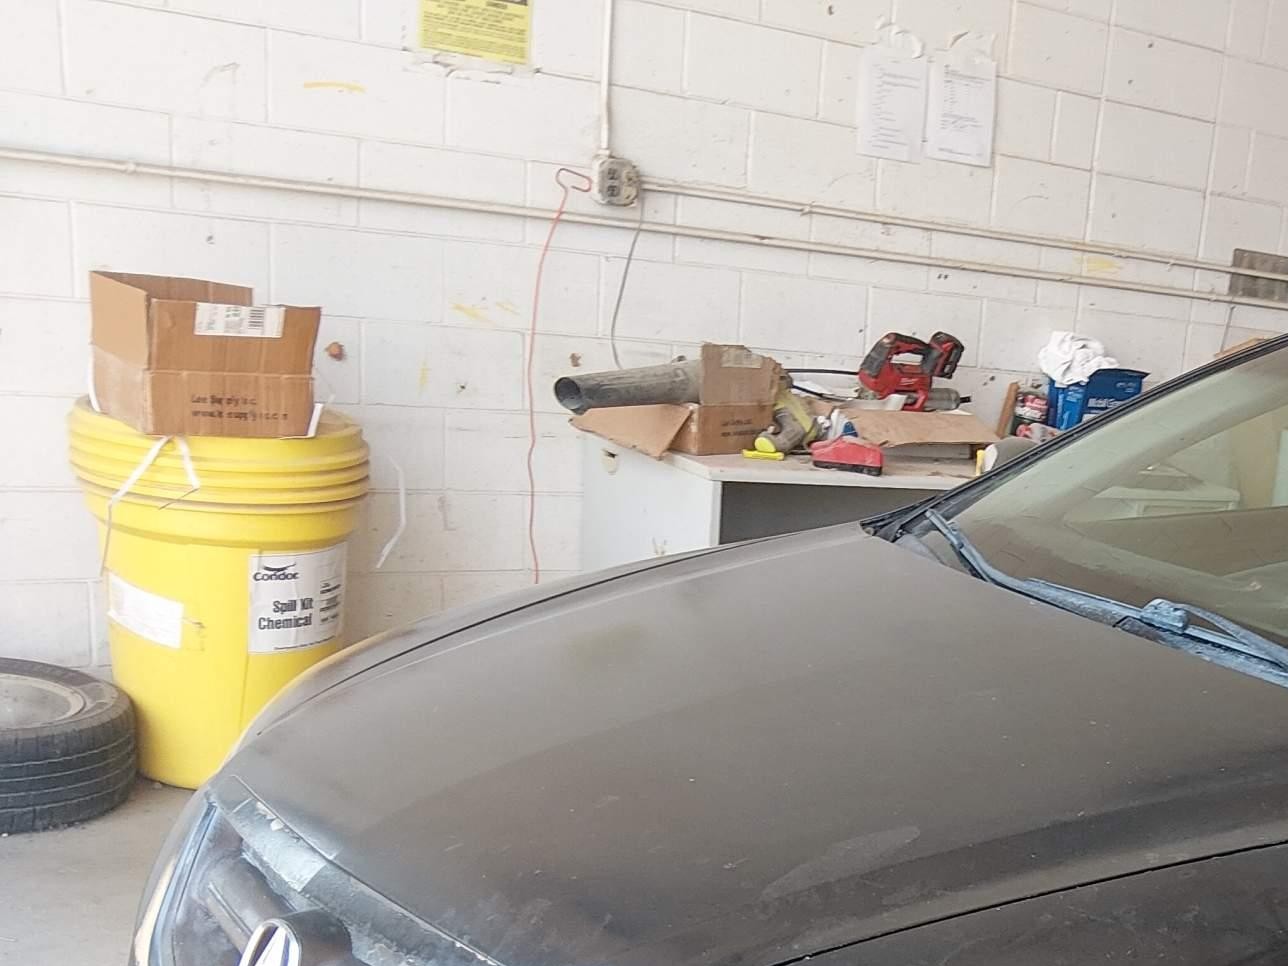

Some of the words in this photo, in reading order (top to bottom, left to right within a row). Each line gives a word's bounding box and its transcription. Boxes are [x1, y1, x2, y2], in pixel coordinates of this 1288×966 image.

[253, 571, 299, 581] Condor
[273, 599, 297, 615] Spill
[258, 612, 312, 630] Chemical
